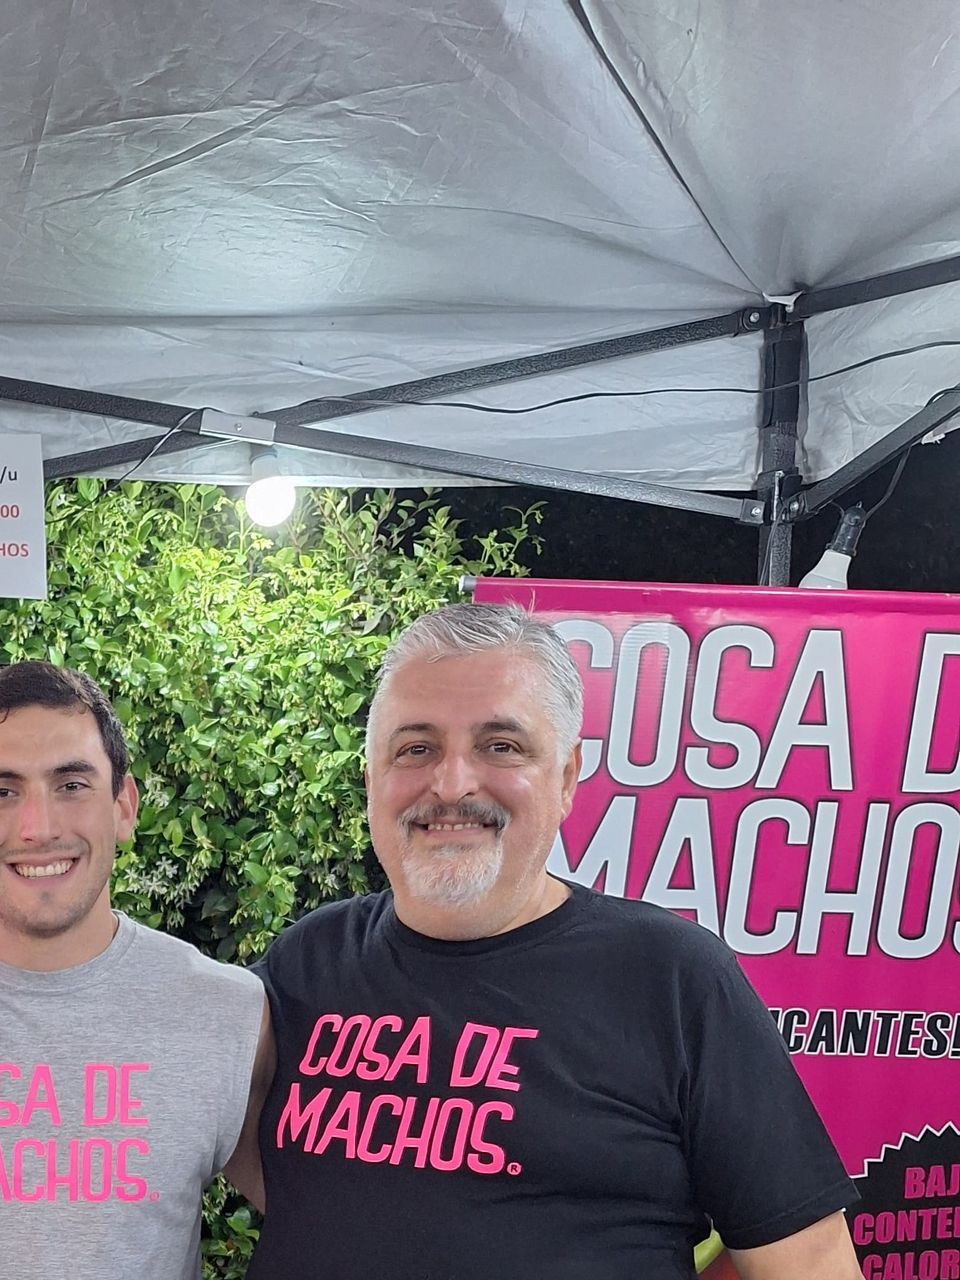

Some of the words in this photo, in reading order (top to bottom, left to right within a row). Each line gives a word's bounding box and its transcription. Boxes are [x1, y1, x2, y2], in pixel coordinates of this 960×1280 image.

[544, 796, 960, 960] MACHO
[298, 1013, 431, 1084] COSA
[449, 1021, 539, 1092] DE
[83, 1062, 151, 1127] DE
